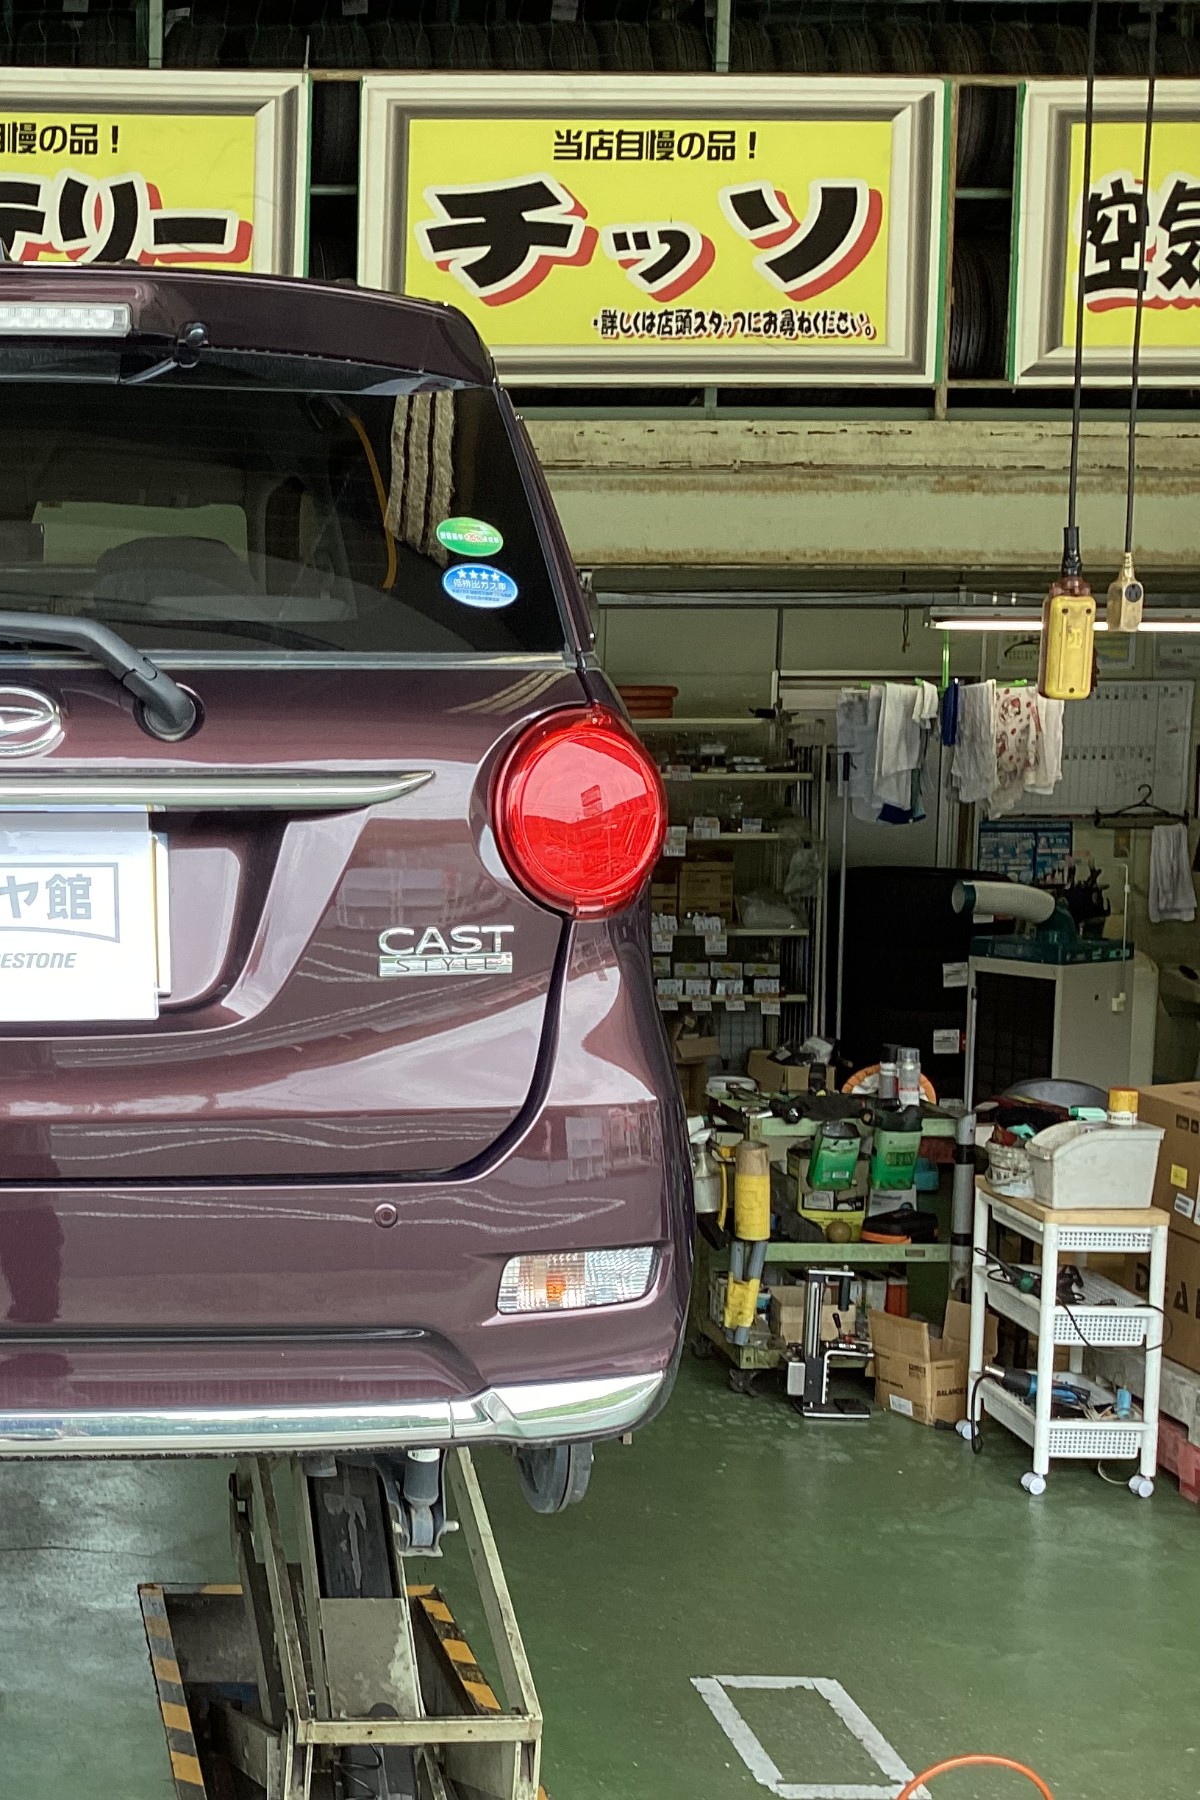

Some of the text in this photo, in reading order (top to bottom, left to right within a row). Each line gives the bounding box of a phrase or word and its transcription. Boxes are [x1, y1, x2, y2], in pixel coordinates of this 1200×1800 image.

[553, 129, 757, 161] 当店自慢の品！
[425, 180, 858, 288] チッソ
[378, 924, 515, 955] CAST
